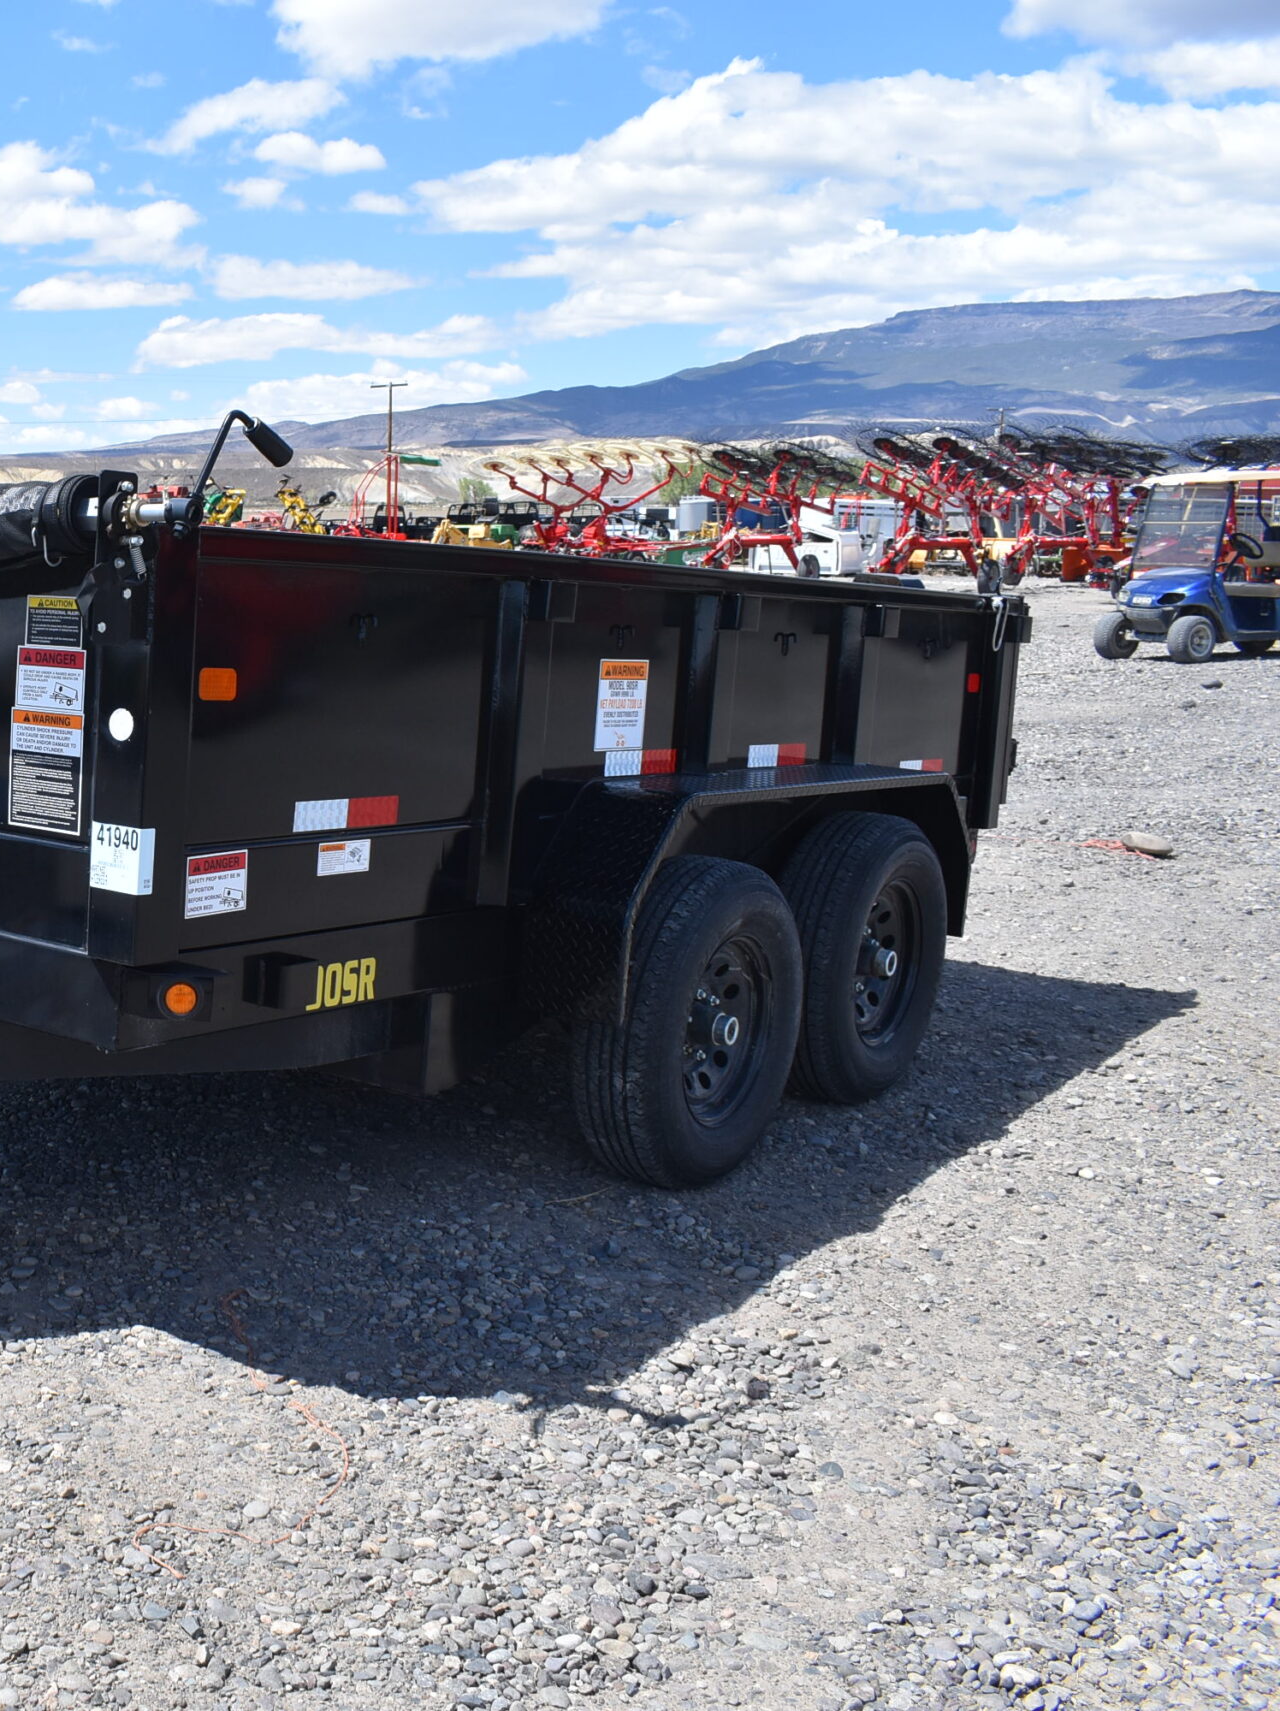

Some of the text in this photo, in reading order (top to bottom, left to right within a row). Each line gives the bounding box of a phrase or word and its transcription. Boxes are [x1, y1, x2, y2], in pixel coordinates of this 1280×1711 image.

[44, 599, 74, 608] CAUTION
[35, 652, 76, 666] DANGER
[612, 665, 644, 676] WARNING
[32, 714, 70, 726] WARNING
[97, 824, 138, 851] 41940
[204, 856, 240, 872] DANGER
